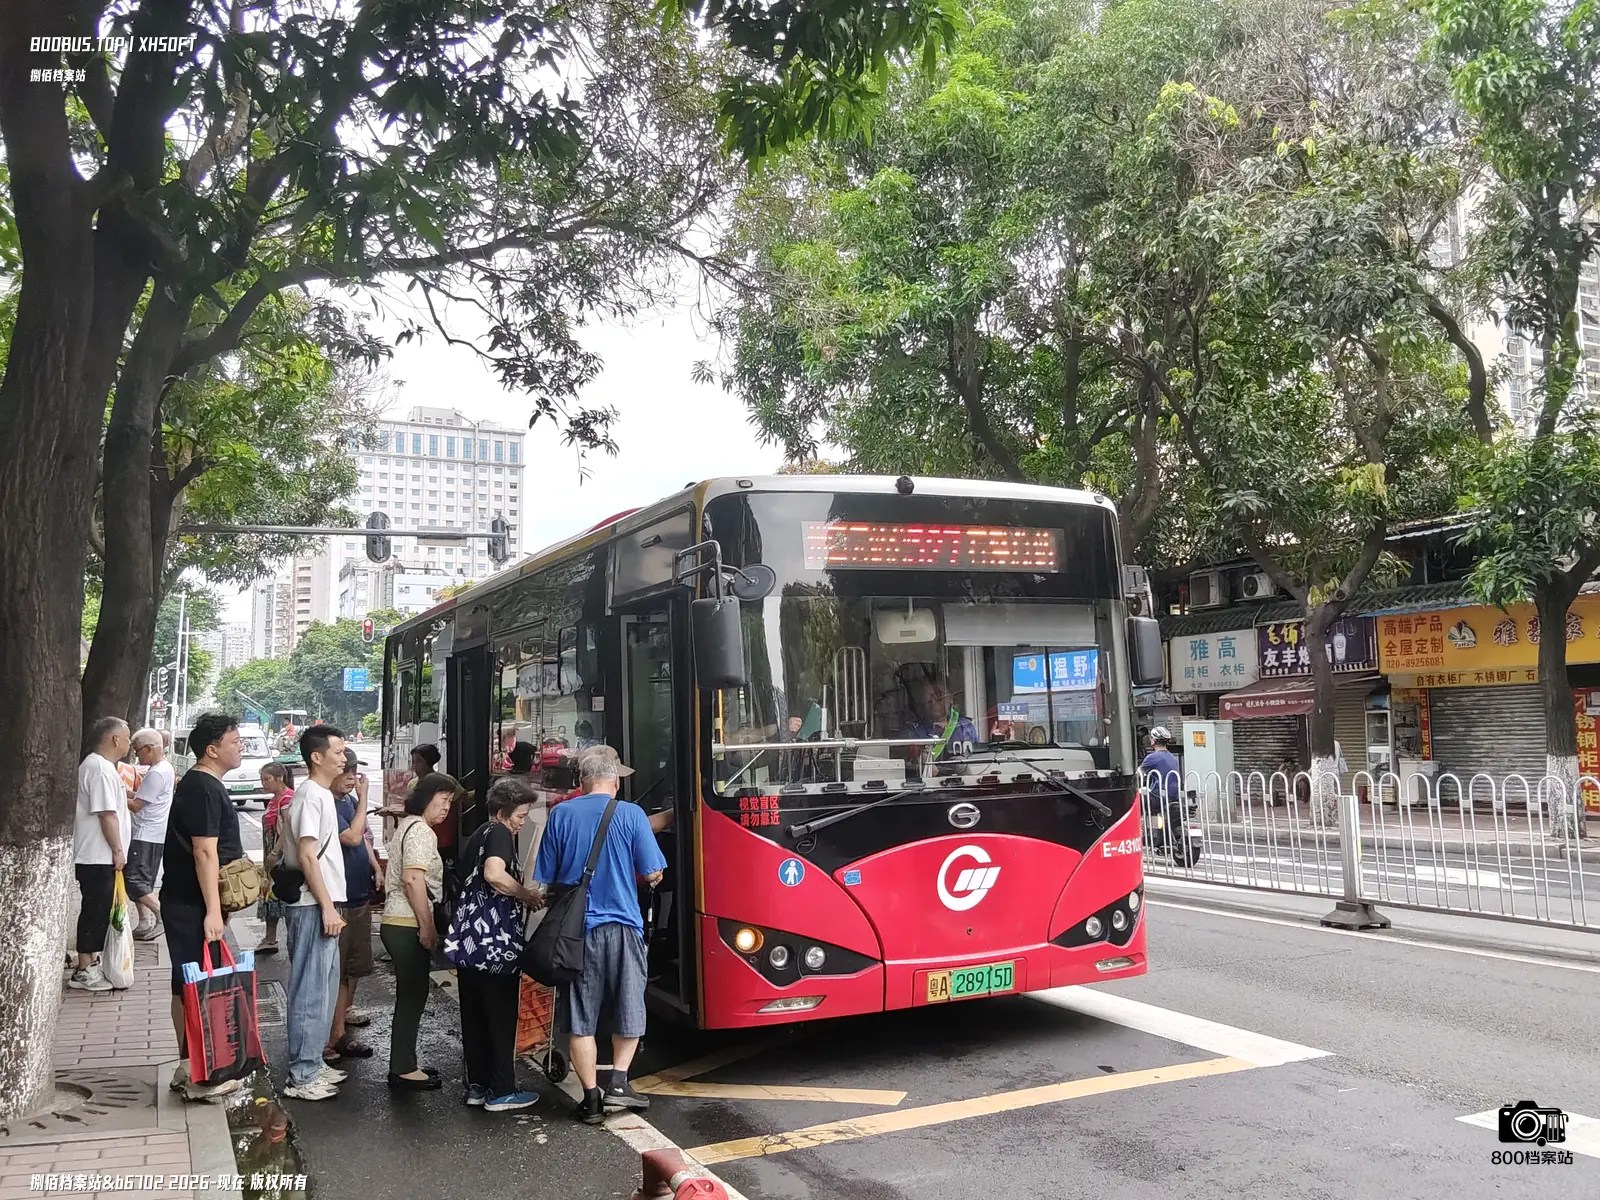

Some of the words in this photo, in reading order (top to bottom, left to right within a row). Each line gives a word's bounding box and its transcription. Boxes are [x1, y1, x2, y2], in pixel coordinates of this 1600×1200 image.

[1383, 616, 1443, 636] 高端产品
[1190, 636, 1236, 661] 雅高
[1385, 637, 1444, 657] 全屋定制
[1184, 666, 1209, 679] 厨柜
[1219, 663, 1245, 677] 衣柜
[1386, 657, 1444, 668] 020-89256081
[1416, 673, 1467, 687] 自有衣柜厂
[1474, 670, 1518, 683] 不锈钢厂
[739, 796, 779, 810] 视觉盲区
[740, 811, 780, 827] 请勿靠近
[956, 967, 1013, 994] 28915D
